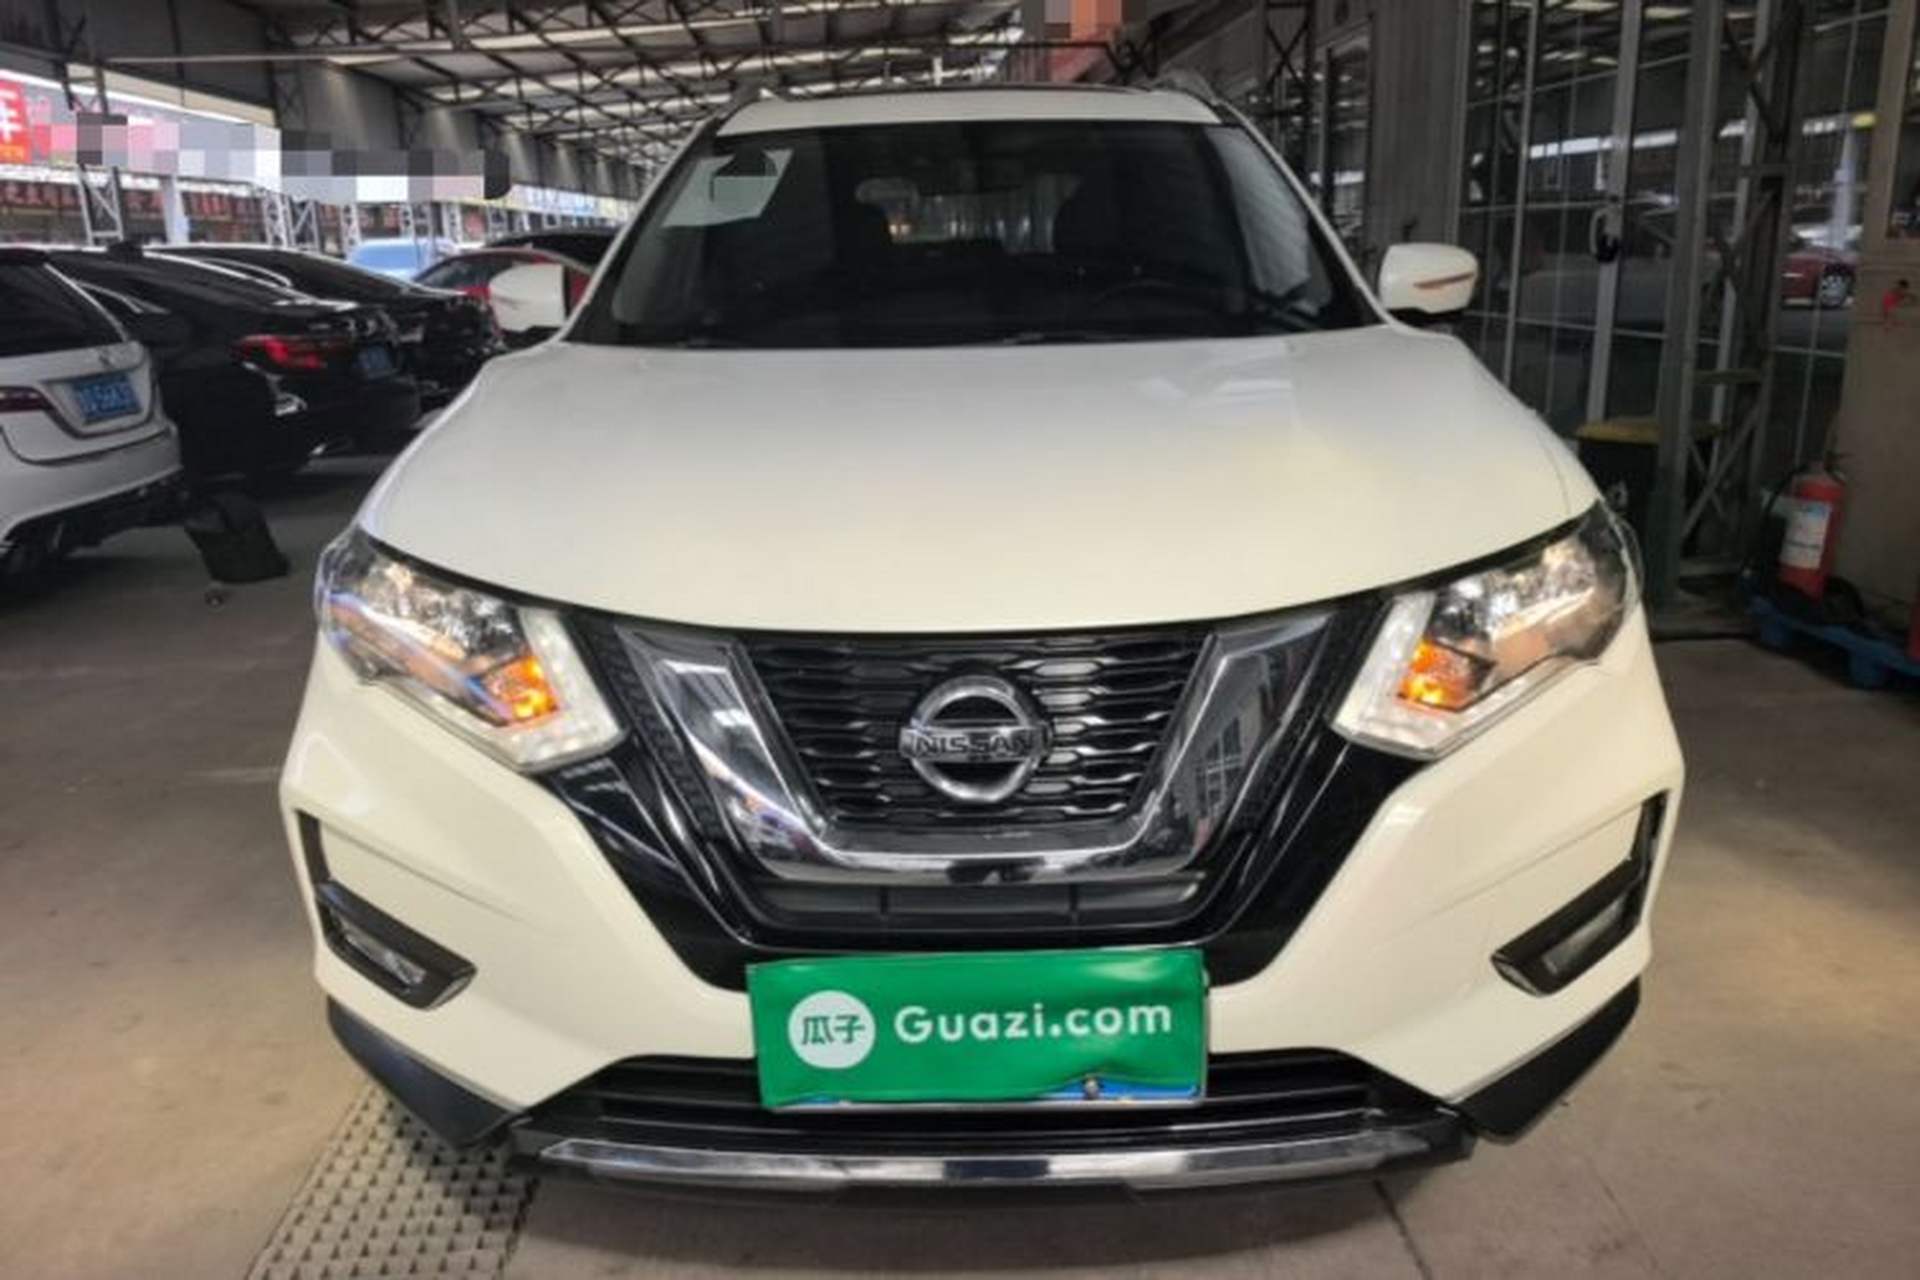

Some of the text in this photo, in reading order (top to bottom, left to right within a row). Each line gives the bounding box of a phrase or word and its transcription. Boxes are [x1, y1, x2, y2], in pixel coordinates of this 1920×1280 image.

[914, 735, 1033, 754] NISSAN
[802, 1014, 865, 1045] 瓜子
[894, 1003, 1172, 1043] Guazi.com
